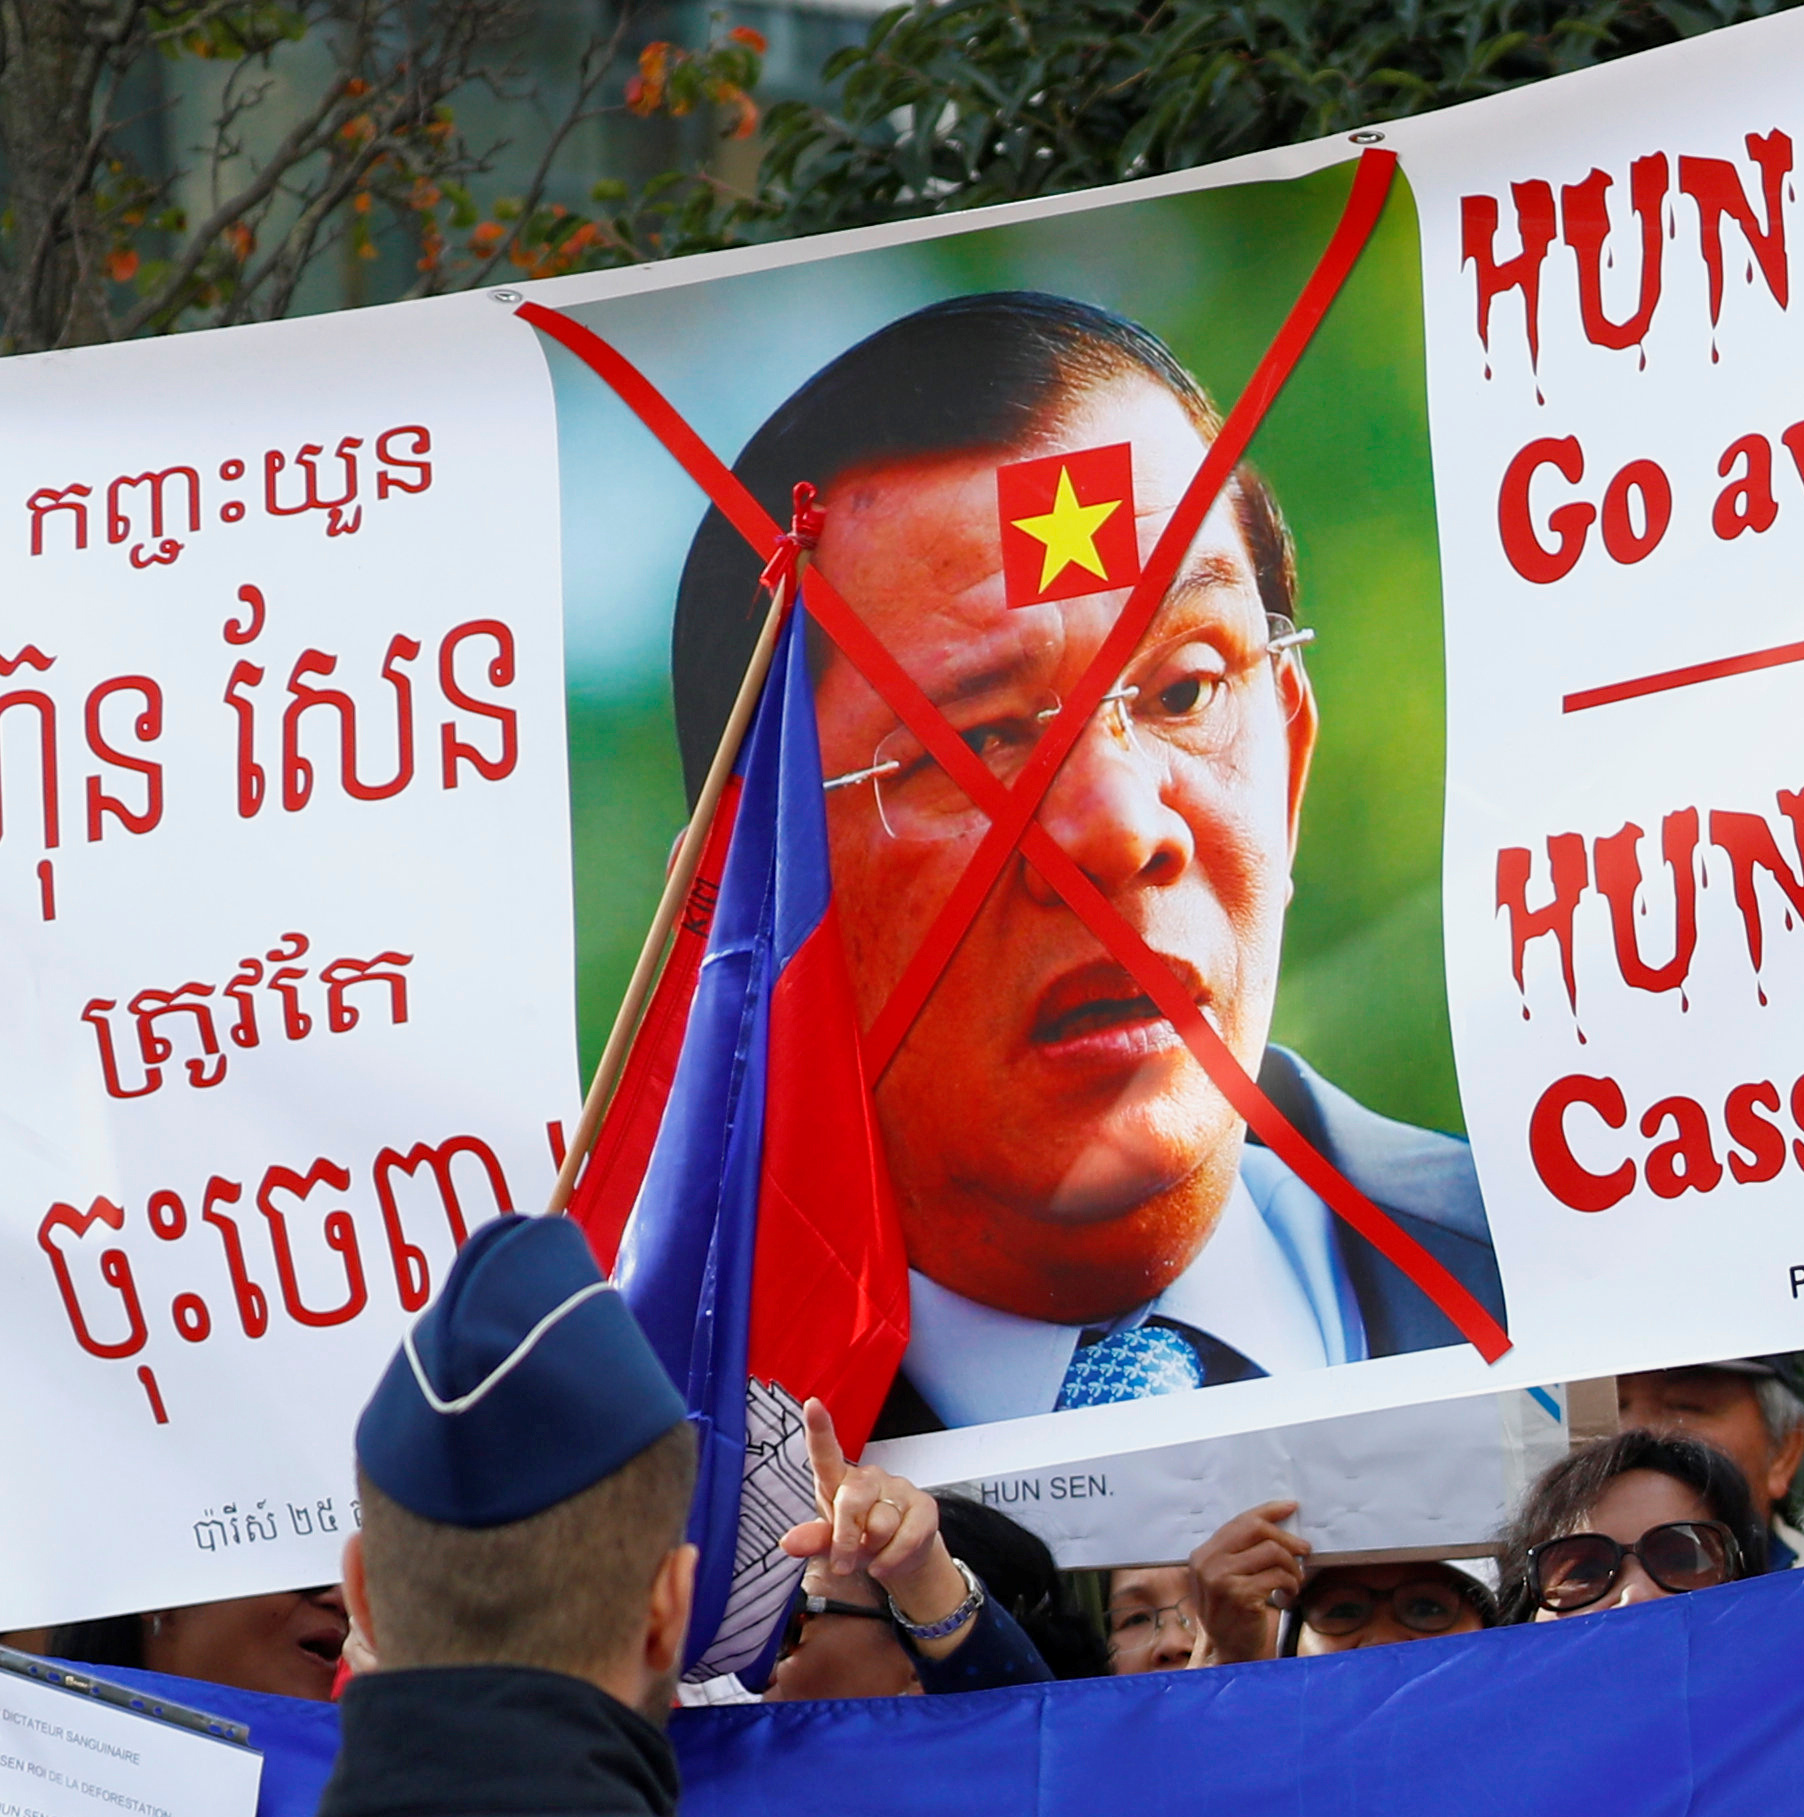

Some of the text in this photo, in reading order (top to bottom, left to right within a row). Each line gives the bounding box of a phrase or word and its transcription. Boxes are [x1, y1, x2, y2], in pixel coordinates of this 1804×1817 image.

[1461, 127, 1795, 406] HUN
[1498, 435, 1672, 584] Go
[980, 1472, 1115, 1504] HUN SEN.
[2, 1708, 141, 1766] DICTATEUR SANGUINAIRE
[27, 1761, 47, 1780] ROI
[48, 1768, 64, 1785] DE
[65, 1773, 79, 1790] LA
